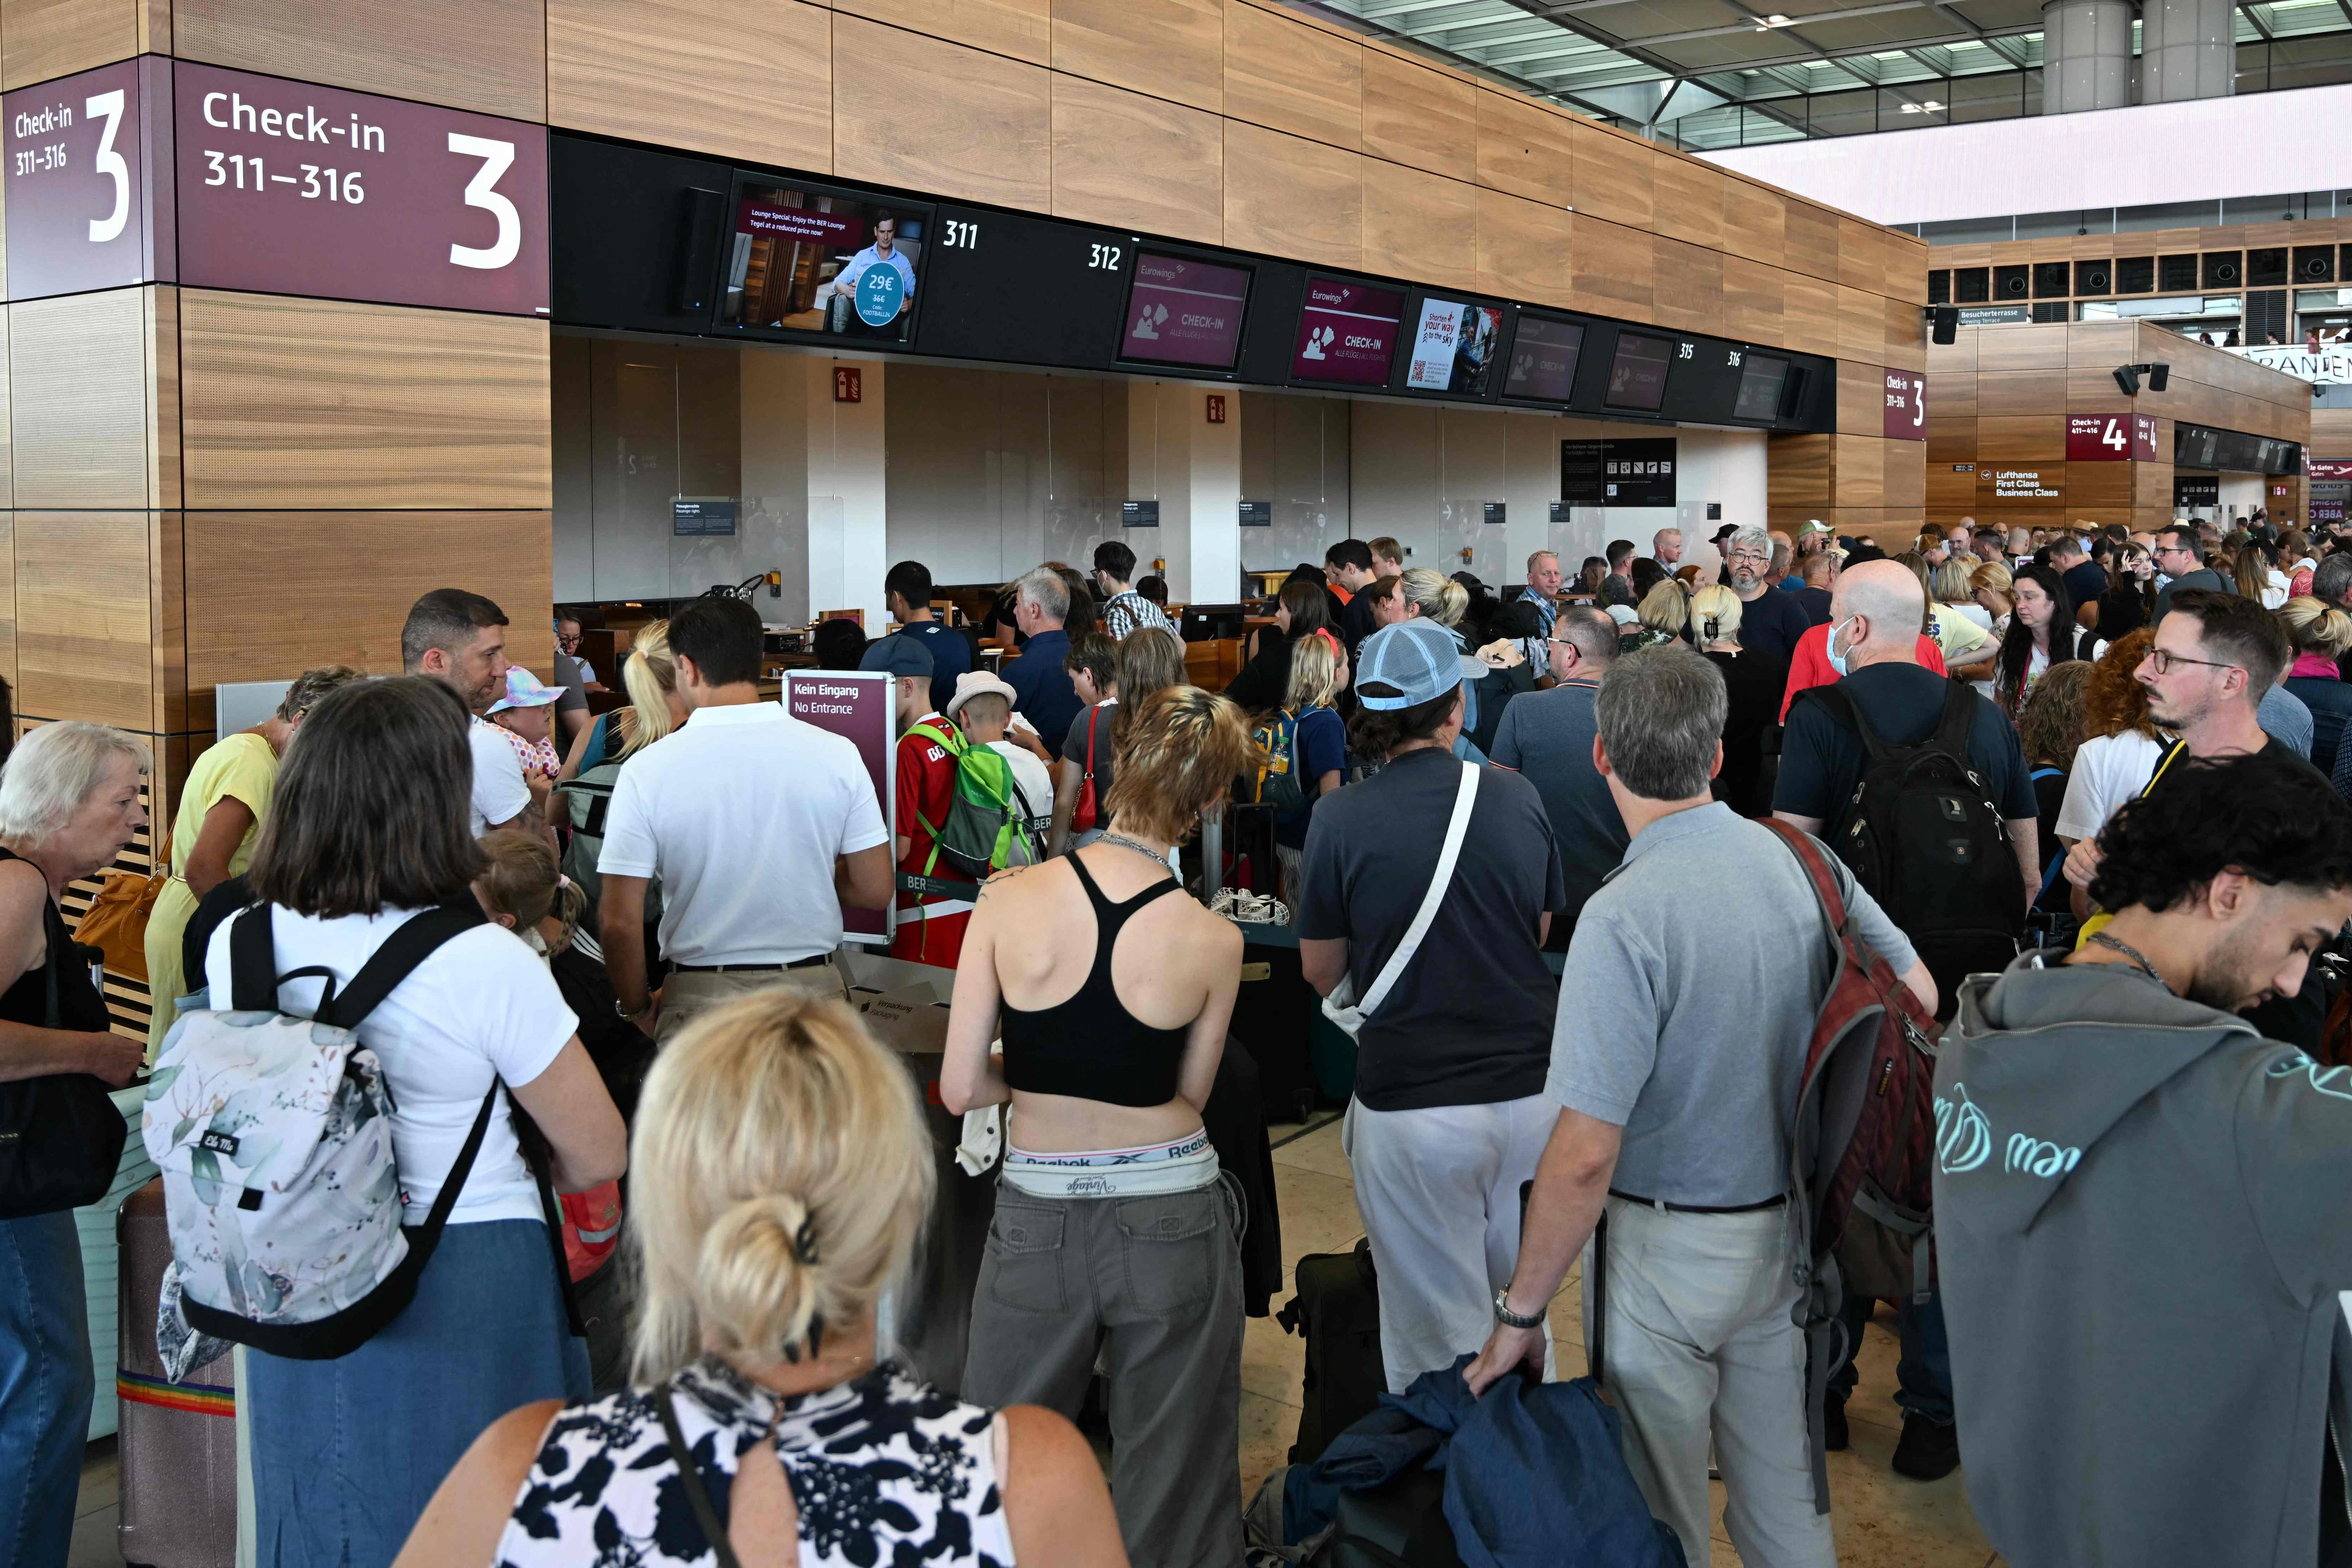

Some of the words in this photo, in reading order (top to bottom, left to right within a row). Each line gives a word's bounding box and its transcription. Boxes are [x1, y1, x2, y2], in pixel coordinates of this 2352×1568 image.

[15, 102, 72, 139] Check-in
[203, 92, 385, 152] Check-in
[16, 142, 67, 176] 311–316
[86, 89, 130, 242] 3
[204, 150, 366, 205] 311–316
[448, 132, 522, 270] 3
[750, 220, 765, 229] Tegel
[776, 224, 797, 233] reduced
[751, 209, 771, 219] Lounge
[772, 213, 791, 221] Special:
[792, 216, 806, 224] Enjoy
[828, 221, 845, 230] Lounge
[943, 220, 978, 249] 311
[1089, 244, 1121, 271] 312
[1141, 265, 1175, 281] Eurowings
[869, 274, 894, 291] 29€
[872, 294, 886, 303] 36€
[1312, 290, 1342, 305] Eurowings
[863, 309, 890, 317] FOOTBALL24
[1429, 313, 1447, 323] Shorten
[1961, 310, 2018, 318] Besucherterrasse
[1181, 313, 1224, 330] CHECK-IN
[1424, 320, 1441, 332] your
[1441, 324, 1455, 335] way
[1345, 335, 1382, 350] CHECK-IN
[1442, 334, 1454, 347] sky
[1679, 343, 1694, 359] 315
[1727, 351, 1741, 367] 316
[1887, 375, 1907, 390] Check-in
[1887, 394, 1904, 408] 311–316
[1913, 380, 1923, 427] 3
[2102, 418, 2126, 451] 4
[2150, 421, 2156, 452] 4
[2016, 479, 2040, 488] Class
[795, 683, 816, 695] Kein
[819, 684, 859, 699] Eingang
[795, 702, 808, 713] No
[811, 702, 853, 715] Entrance
[1034, 817, 1051, 830] BER
[908, 875, 926, 891] BER
[870, 1008, 900, 1021] Packaging
[878, 999, 913, 1014] Verpackung
[1168, 1131, 1208, 1158] Reebo
[1067, 1178, 1116, 1195] Vintage
